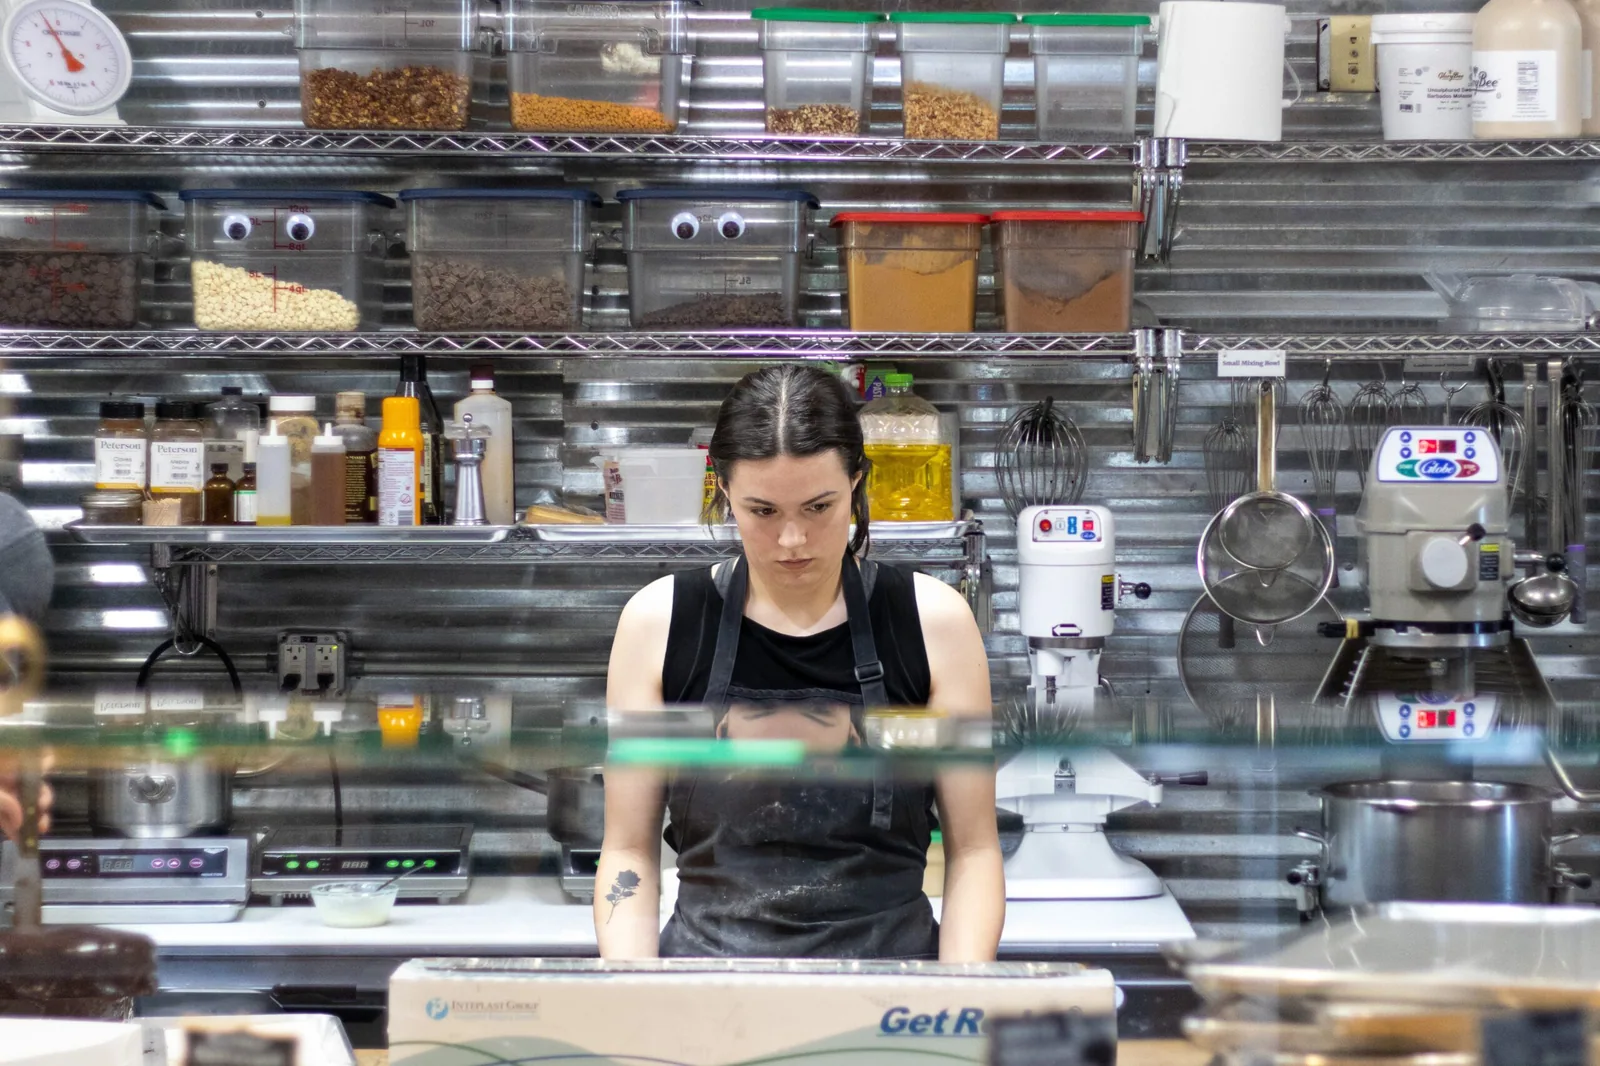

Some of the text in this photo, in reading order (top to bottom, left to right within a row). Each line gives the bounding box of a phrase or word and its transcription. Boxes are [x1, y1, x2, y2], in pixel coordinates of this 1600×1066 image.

[100, 441, 141, 450] Peterson
[157, 445, 197, 453] Peterson
[1421, 460, 1455, 474] Globe
[880, 1006, 950, 1034] Get
